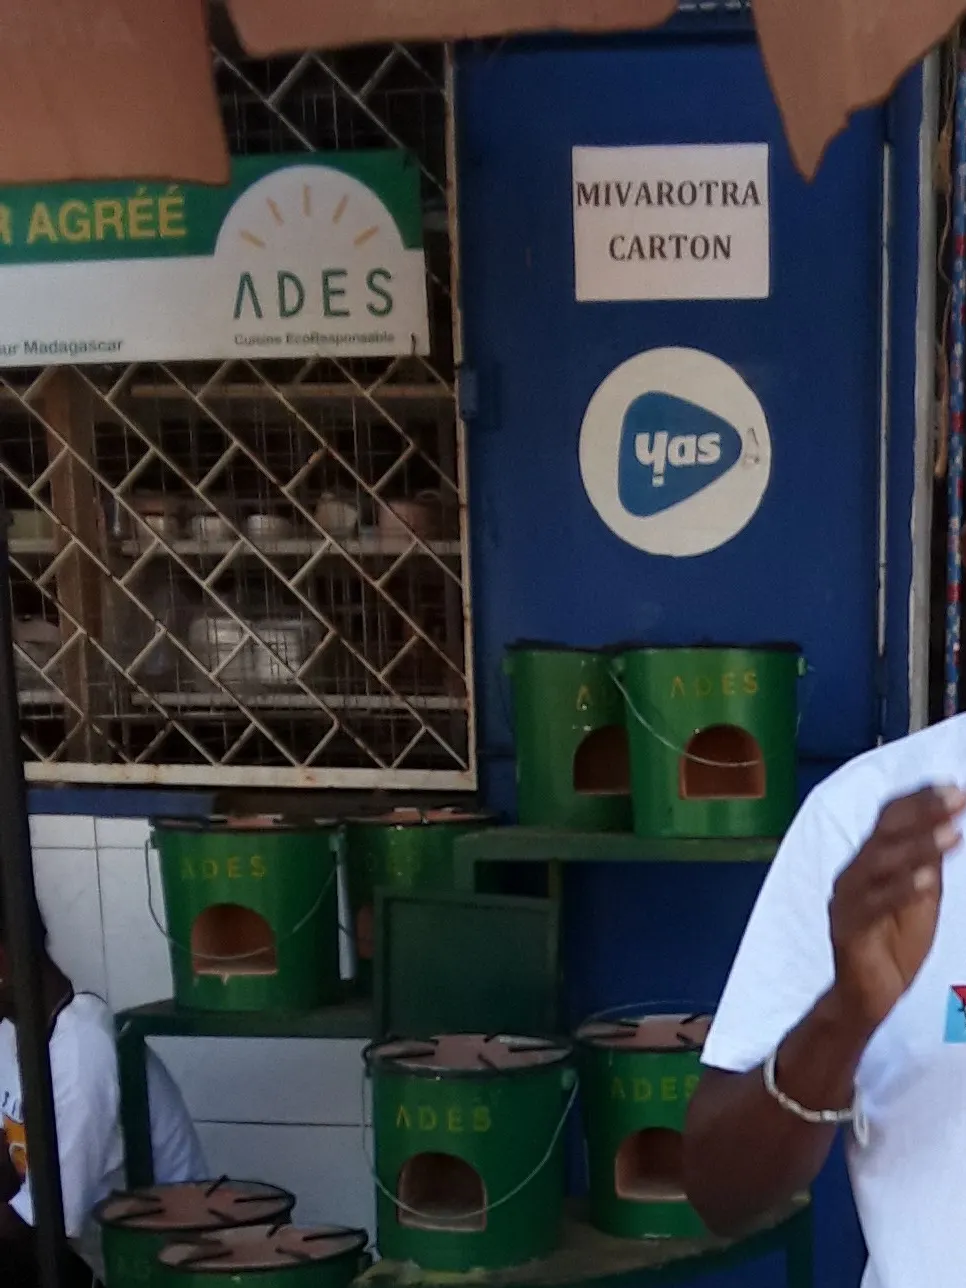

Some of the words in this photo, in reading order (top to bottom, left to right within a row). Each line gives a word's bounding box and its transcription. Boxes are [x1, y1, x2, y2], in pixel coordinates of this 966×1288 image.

[576, 180, 762, 208] MIVAROTRA
[26, 183, 188, 245] AGRÉÉ
[608, 234, 732, 261] CARTON
[233, 267, 394, 319] ADES
[23, 339, 123, 357] Madagascar
[634, 430, 722, 488] yas
[669, 670, 760, 700] ADES
[180, 855, 268, 879] ADES
[394, 1103, 492, 1132] ADES
